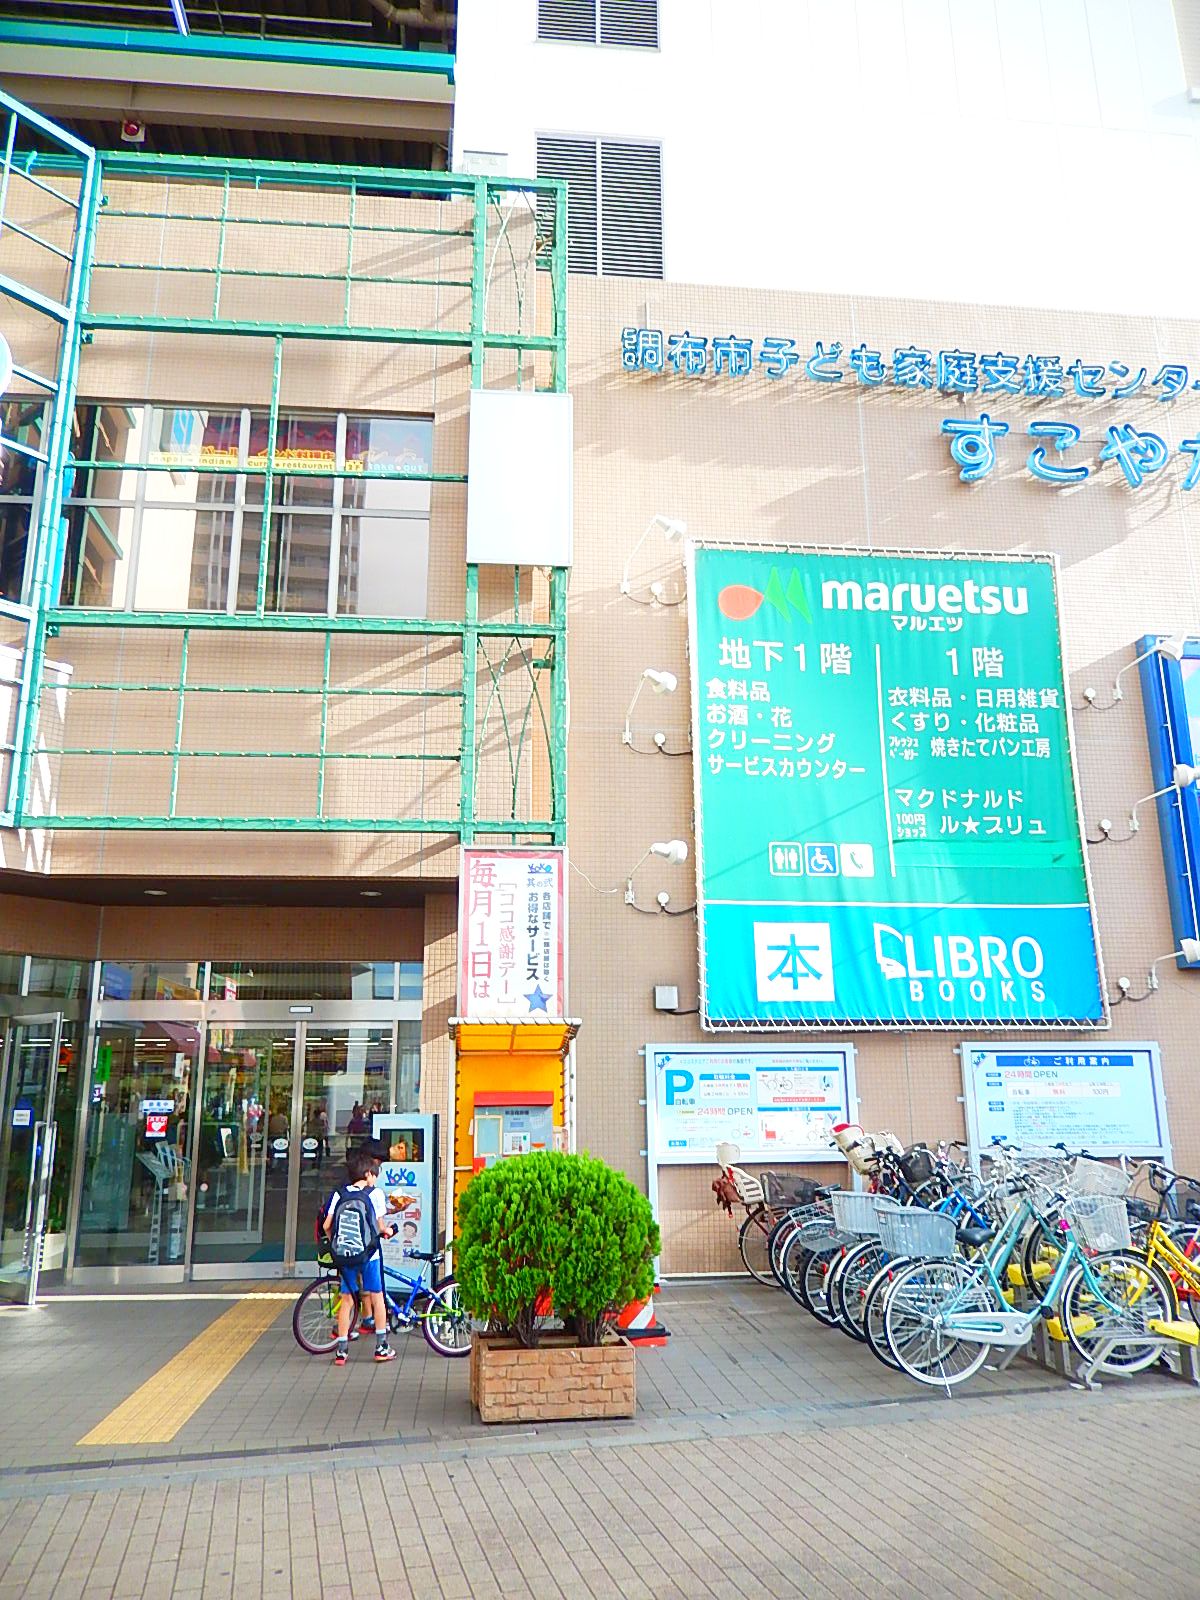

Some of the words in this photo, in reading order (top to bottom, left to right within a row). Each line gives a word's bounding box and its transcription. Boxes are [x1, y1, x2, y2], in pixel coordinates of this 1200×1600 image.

[282, 462, 334, 470] restaurant
[821, 578, 1029, 615] maruetsu
[890, 615, 964, 632] マルエツ
[718, 637, 853, 676] 地下1階
[944, 646, 1005, 679] 1階
[706, 678, 771, 703] 食料品
[888, 686, 1060, 709] 衣料品・日用雑貨
[706, 704, 793, 728] お酒・花
[890, 711, 1040, 734] くすり・化粧品
[707, 728, 836, 754] クリーニング
[930, 736, 1052, 760] 焼きたてパン工房
[707, 754, 867, 780] サービスカウンター
[894, 788, 1024, 810] マクドナルド
[895, 813, 926, 826] 100円
[526, 891, 540, 981] お得なサービス
[767, 934, 823, 990] 本
[904, 935, 1044, 979] LIBRO
[909, 980, 1045, 1002] BOOKS
[1053, 1056, 1110, 1066] ご利用案内
[665, 1069, 694, 1105] P
